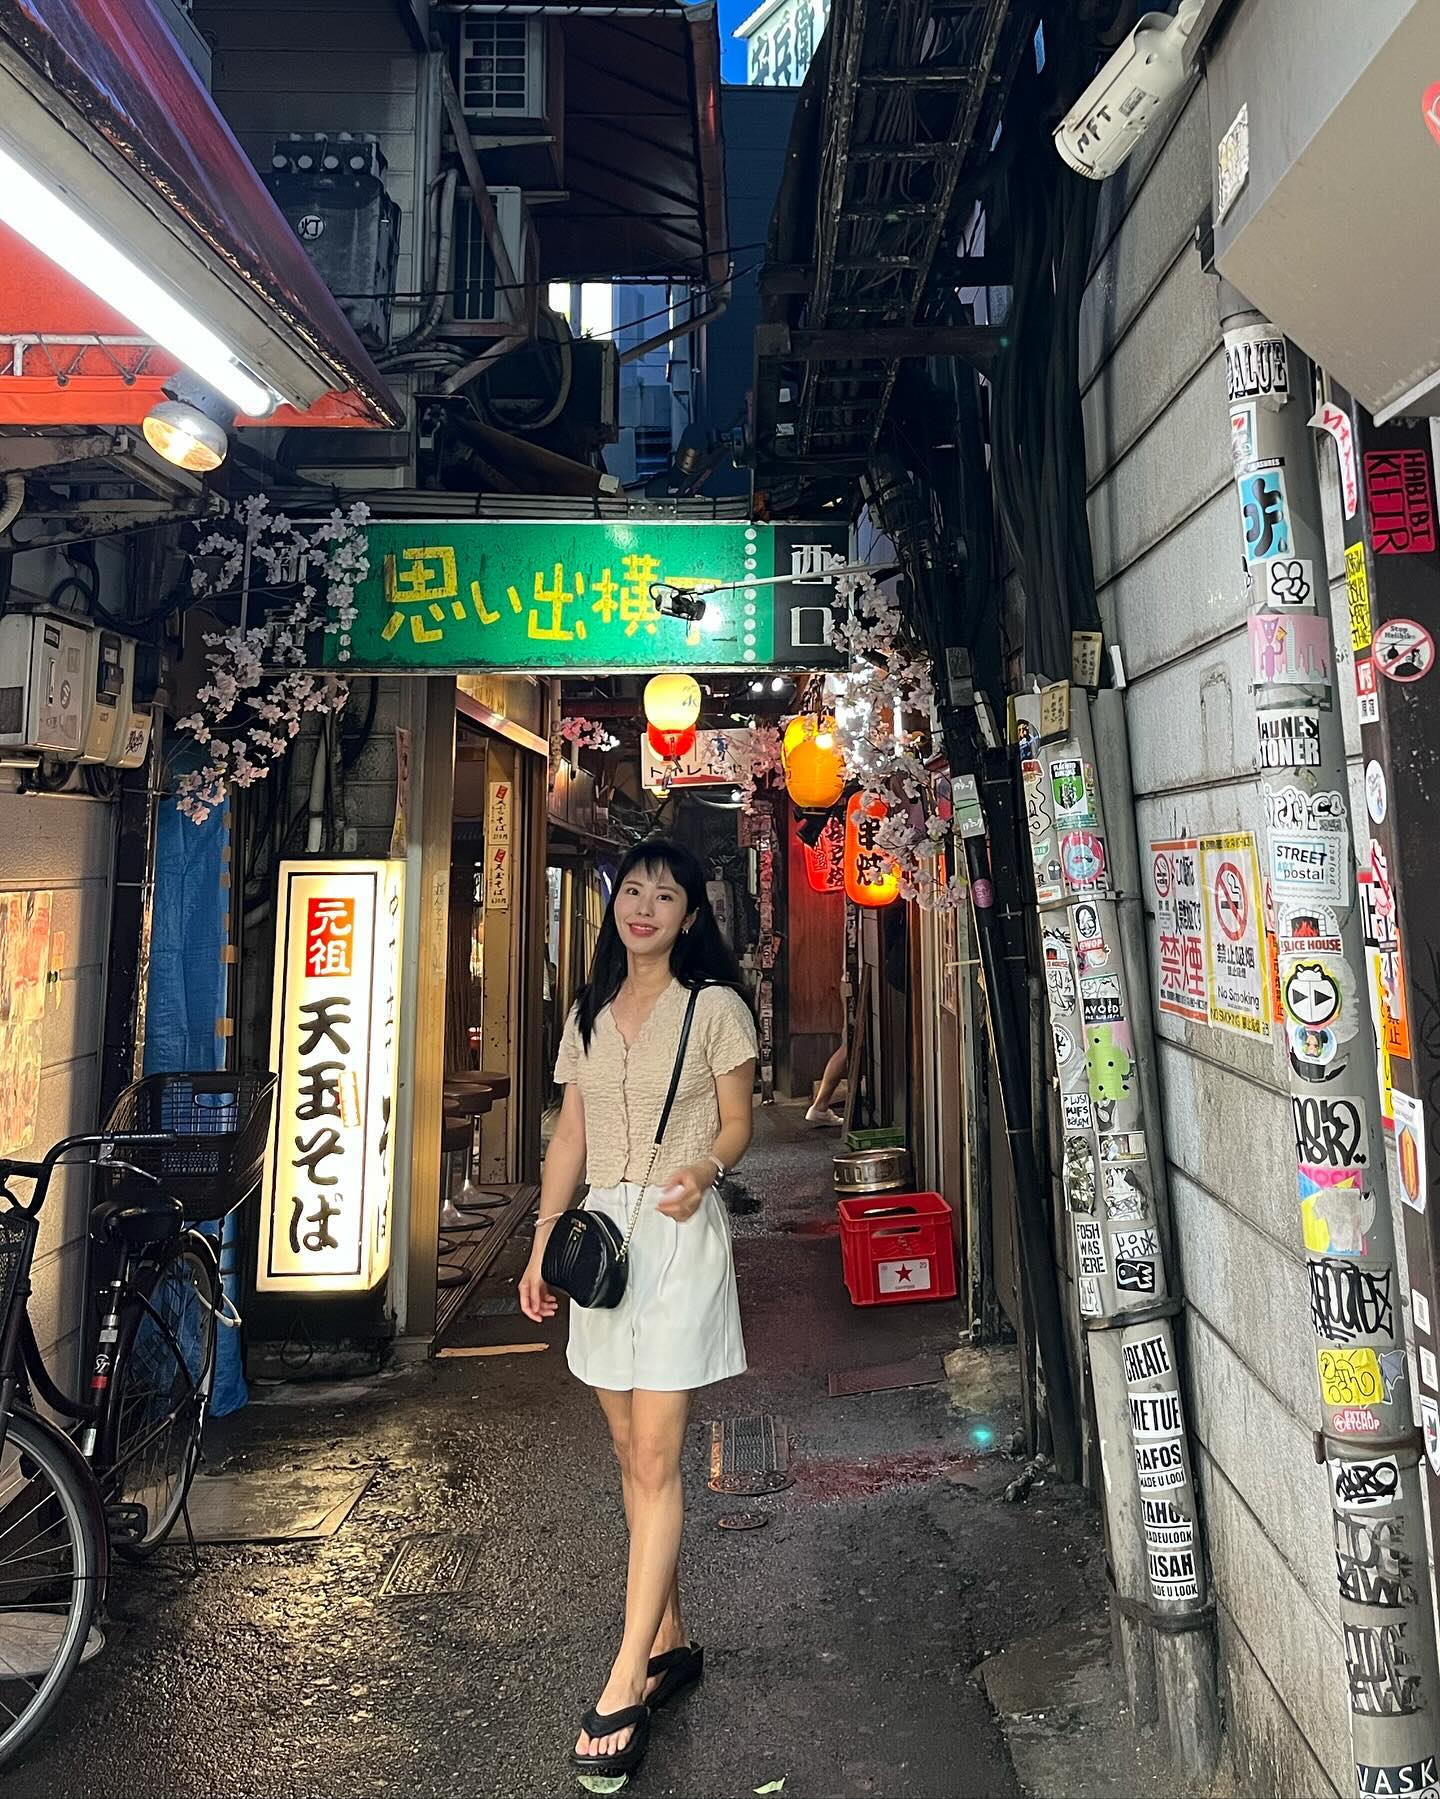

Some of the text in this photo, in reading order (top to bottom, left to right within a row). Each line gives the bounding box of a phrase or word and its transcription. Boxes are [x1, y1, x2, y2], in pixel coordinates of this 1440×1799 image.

[791, 544, 834, 647] 西口
[1390, 625, 1408, 633] Stop
[650, 764, 702, 778] トイレ
[1276, 845, 1327, 866] STREET
[1329, 844, 1337, 884] project
[1284, 867, 1325, 881] postal
[309, 901, 352, 976] 元祖
[1284, 938, 1342, 952] SLICE HOUSE
[1159, 931, 1206, 997] 禁煙
[1217, 985, 1228, 999] No
[1228, 988, 1260, 1011] Smoking
[1084, 1003, 1120, 1015] AVOID
[289, 996, 351, 1254] 天玉そば
[1079, 1240, 1101, 1256] WAS
[1081, 1256, 1106, 1274] HERE
[1122, 1336, 1170, 1383] CREATE
[1343, 1410, 1372, 1422] EXTRA
[1159, 1475, 1164, 1486] U
[1141, 1500, 1192, 1524] TAHO
[1167, 1584, 1173, 1597] U
[1175, 1583, 1198, 1597] LOOK
